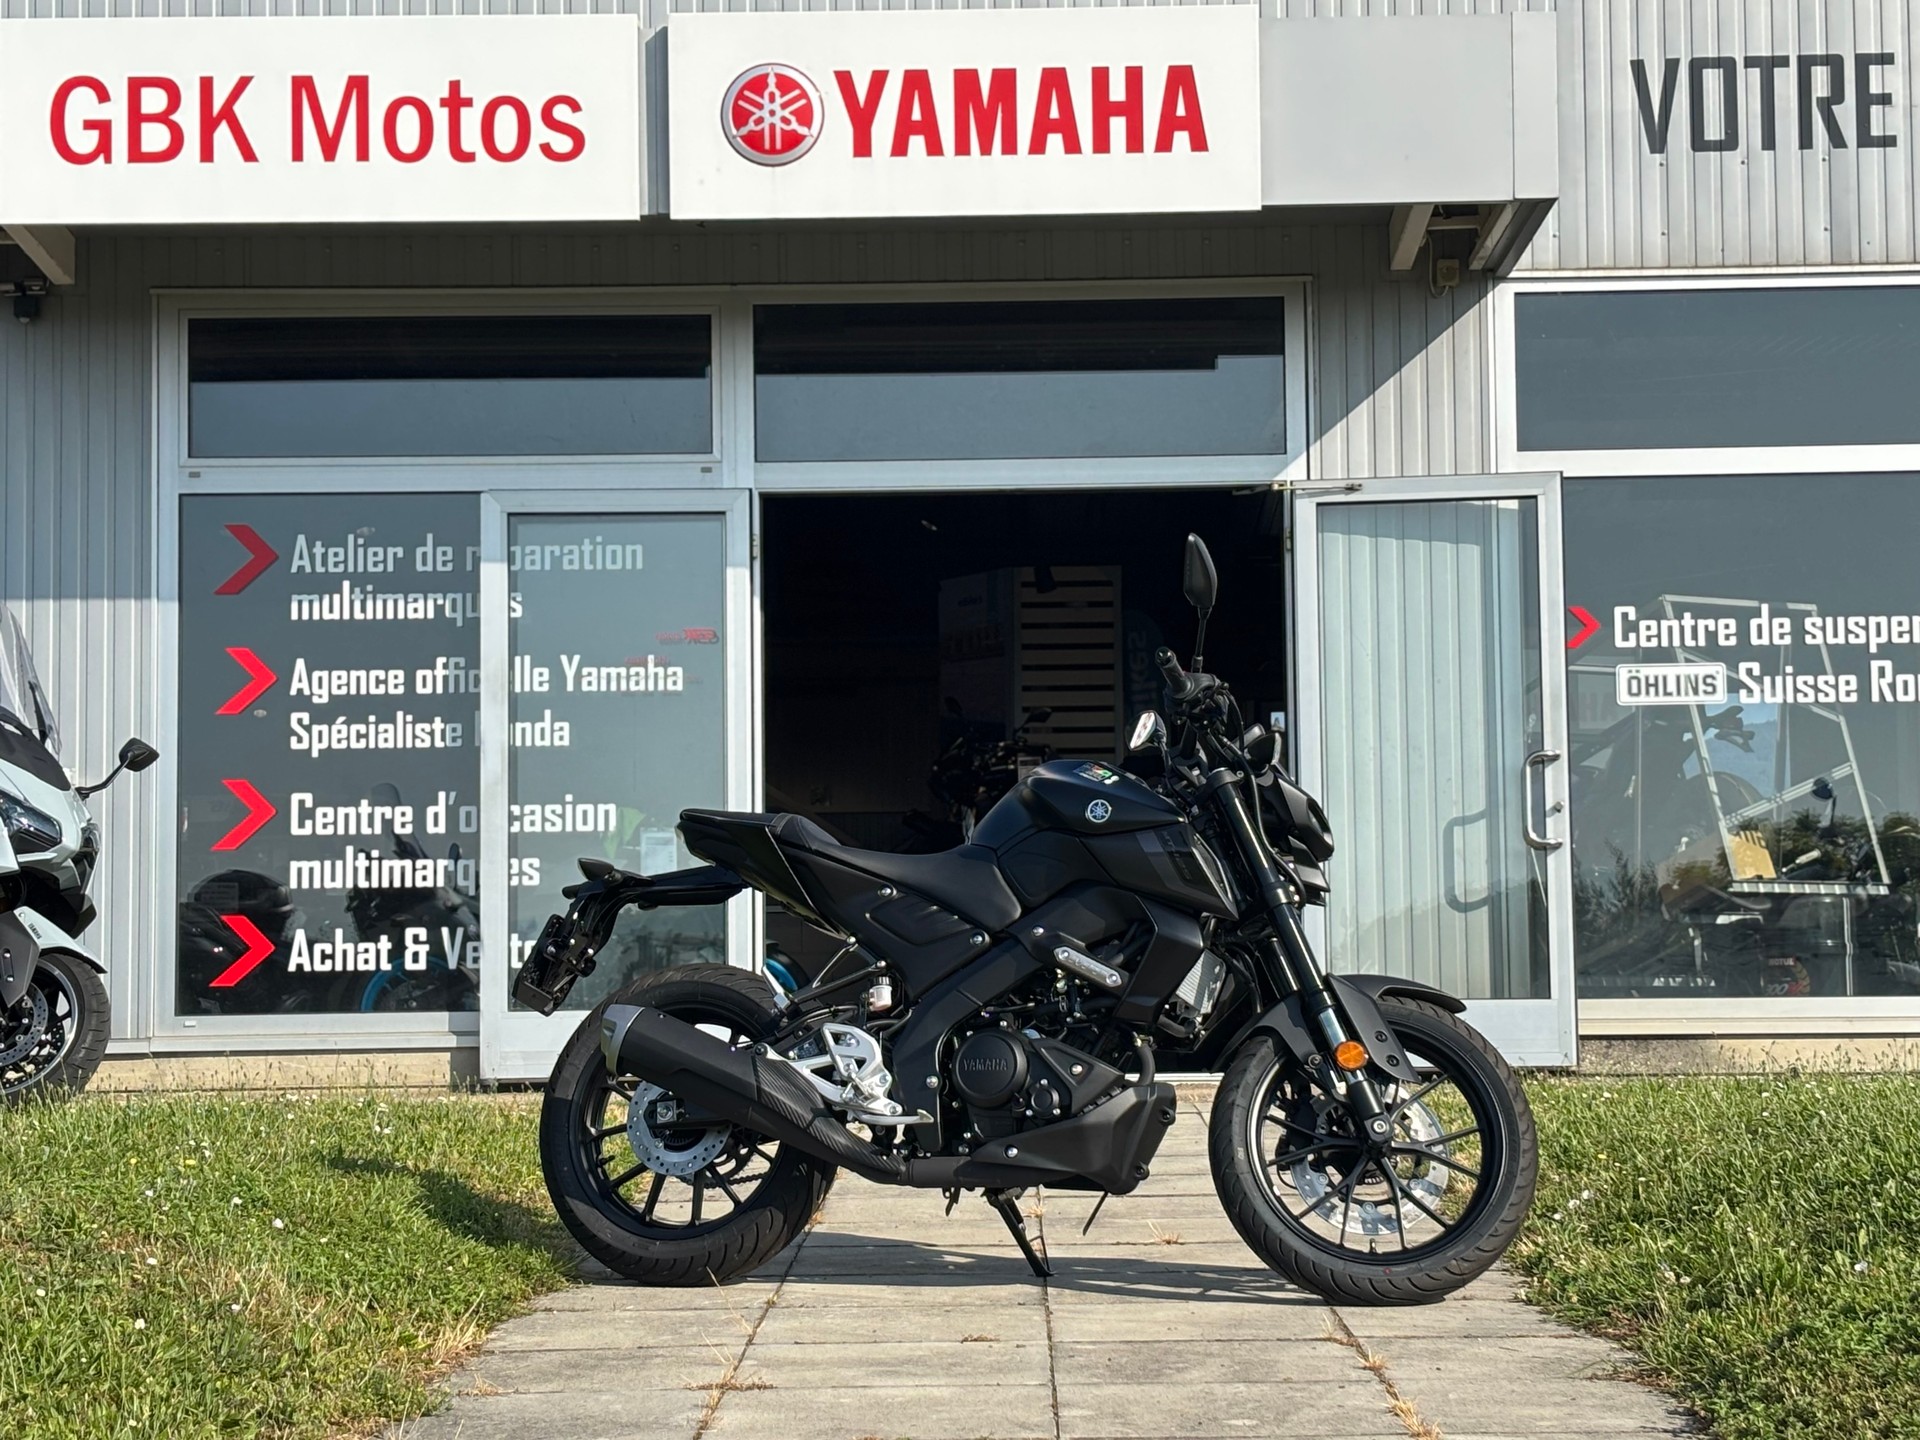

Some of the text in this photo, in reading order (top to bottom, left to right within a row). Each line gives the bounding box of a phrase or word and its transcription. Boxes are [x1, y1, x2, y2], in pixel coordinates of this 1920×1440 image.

[50, 75, 586, 165] GBK Motos
[833, 65, 1209, 157] YAMAHA
[1630, 52, 1897, 154] VOTRE
[290, 533, 643, 573] Atelier de raration
[290, 580, 523, 627] multimarqus
[1613, 605, 1738, 648] Centre
[1749, 603, 1793, 646] de
[289, 654, 683, 703] Agence officlle Yamaha
[1627, 669, 1718, 698] ÖHLINS
[1738, 659, 1920, 703] Suisse Ro
[289, 709, 570, 757] Spécialiste nda
[290, 791, 616, 836] Centre d'ocasion
[289, 845, 540, 895] multimarqes
[288, 926, 537, 973] Achat & Vet
[962, 1058, 1008, 1071] YAMAHA
